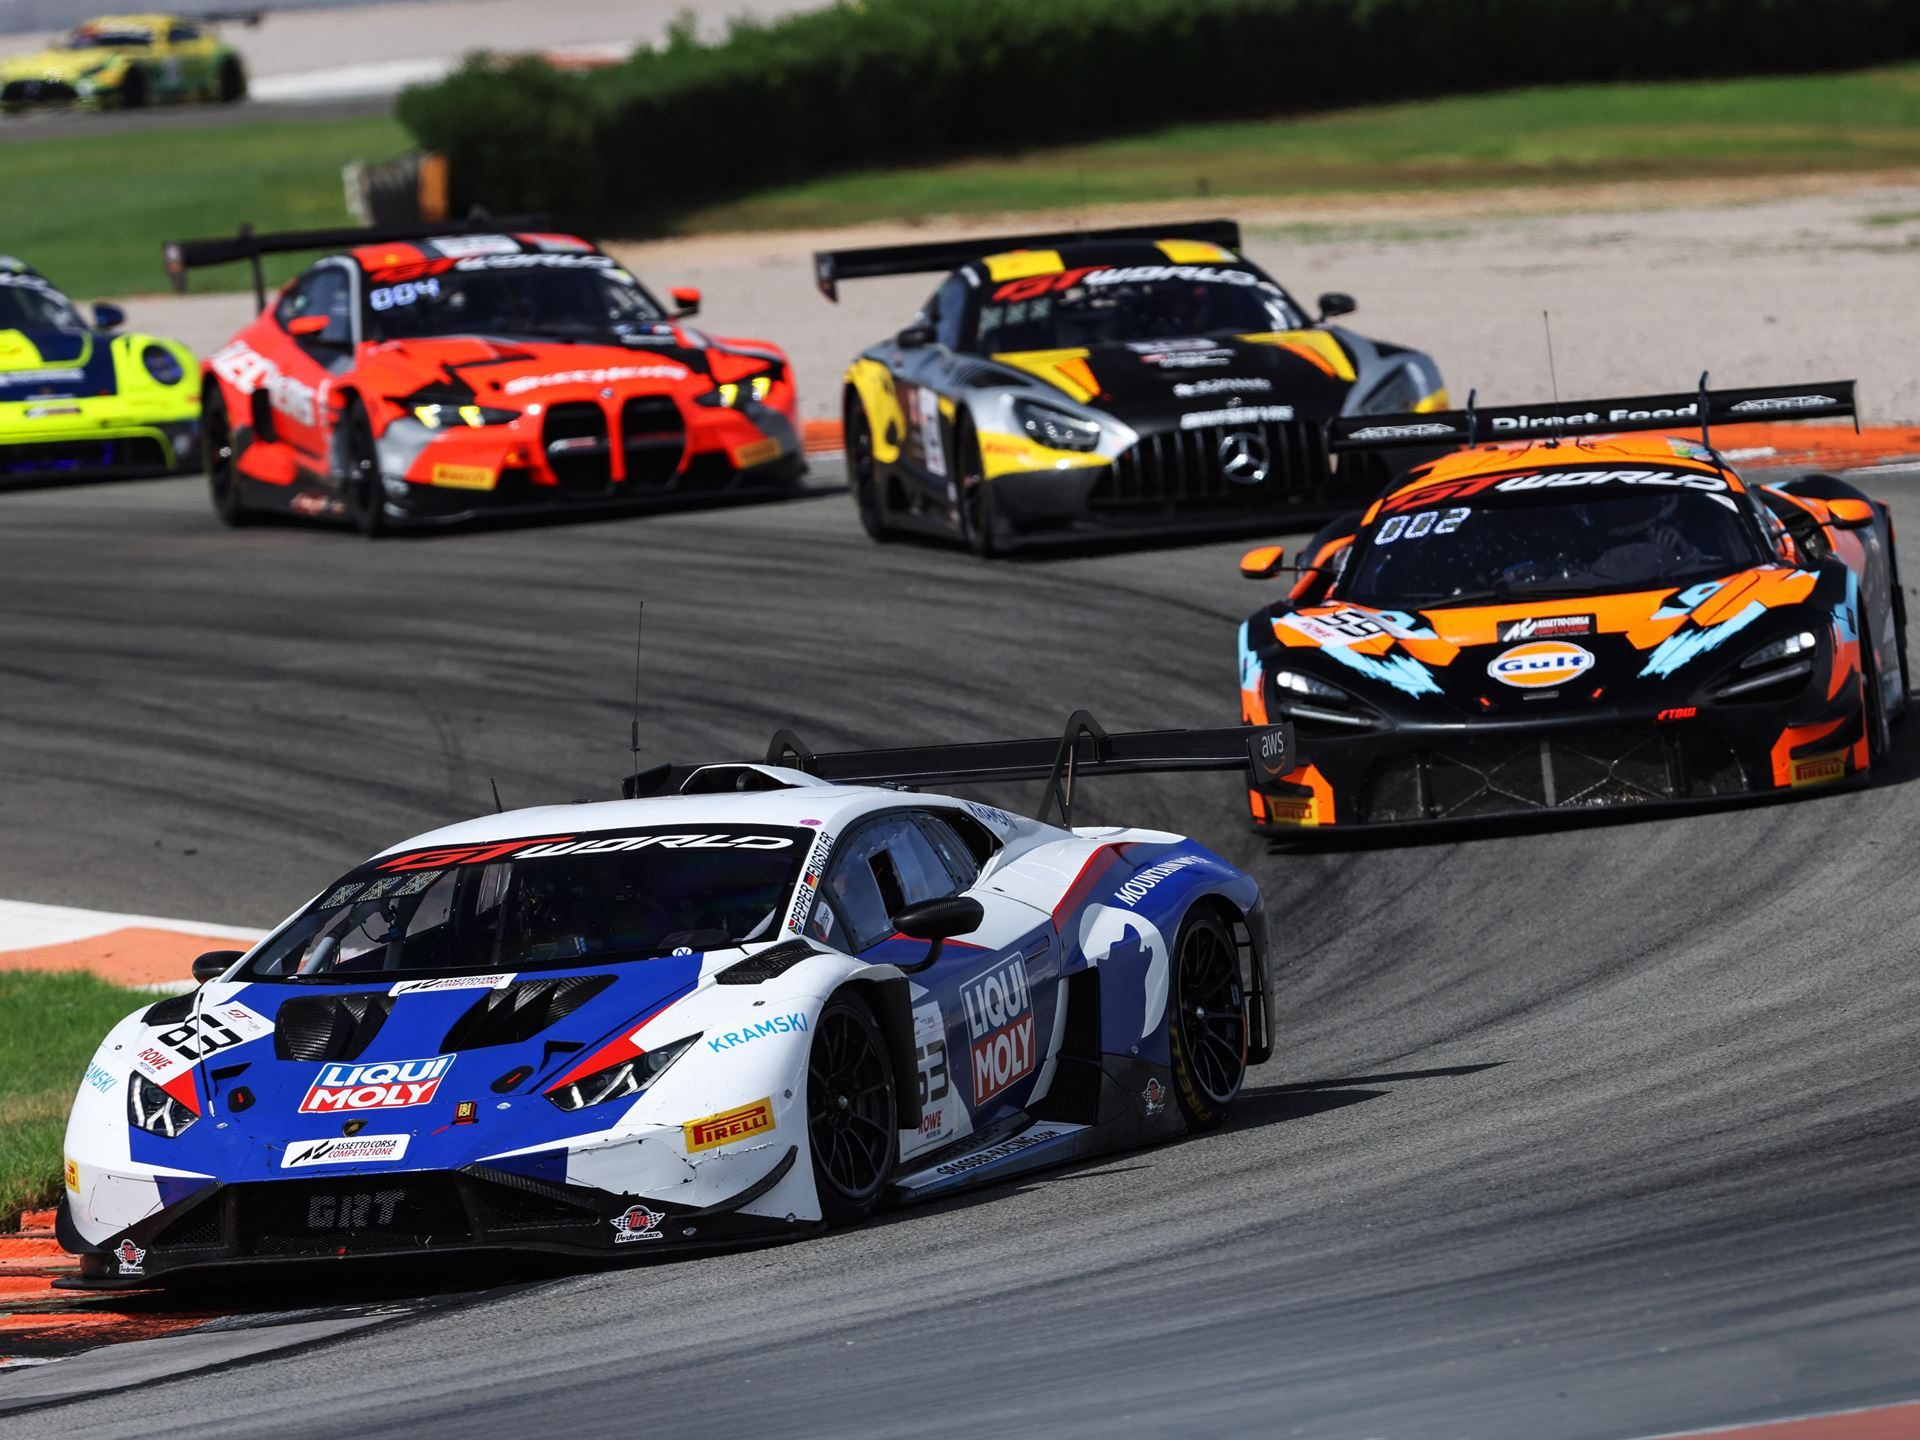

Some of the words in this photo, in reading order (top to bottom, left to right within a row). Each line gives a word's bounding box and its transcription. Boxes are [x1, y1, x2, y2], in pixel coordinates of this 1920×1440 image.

[1491, 415, 1598, 430] Direct
[1609, 403, 1697, 422] Food
[1374, 507, 1472, 546] 002
[1498, 655, 1585, 674] Gulf
[1262, 731, 1284, 758] aws
[1795, 757, 1844, 781] PIRELLI
[806, 831, 835, 878] ENGSTLER
[791, 884, 814, 926] PEPPER
[964, 959, 1029, 1040] LIQUI
[157, 1013, 244, 1061] 63
[707, 1012, 809, 1054] KRAMSKI
[137, 1047, 174, 1071] ROWE
[321, 1057, 449, 1087] LIQUI
[975, 1017, 1033, 1099] MOLY
[307, 1079, 440, 1110] MOLY
[692, 1105, 769, 1146] PIRELLI
[328, 1147, 394, 1159] COMPETIZIONE
[335, 1141, 371, 1150] ASSETTO
[370, 1140, 398, 1149] CORSA
[307, 1189, 406, 1228] GRT
